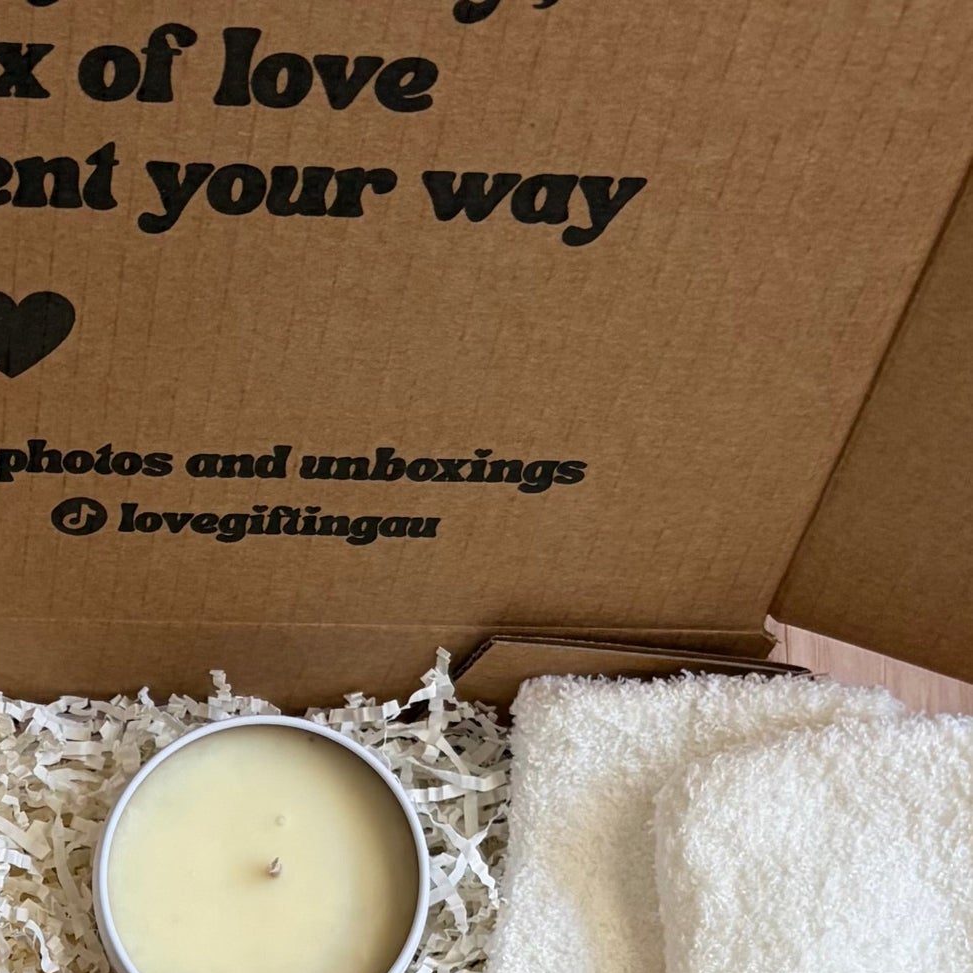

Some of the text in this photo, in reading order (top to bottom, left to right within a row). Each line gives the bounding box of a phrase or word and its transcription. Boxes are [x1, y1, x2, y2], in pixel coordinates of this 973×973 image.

[78, 23, 197, 103] of
[213, 27, 438, 113] love
[137, 160, 397, 234] your
[421, 169, 647, 247] way
[185, 445, 292, 480] and
[299, 447, 587, 493] unboxings
[117, 503, 441, 545] lovegiftingau
